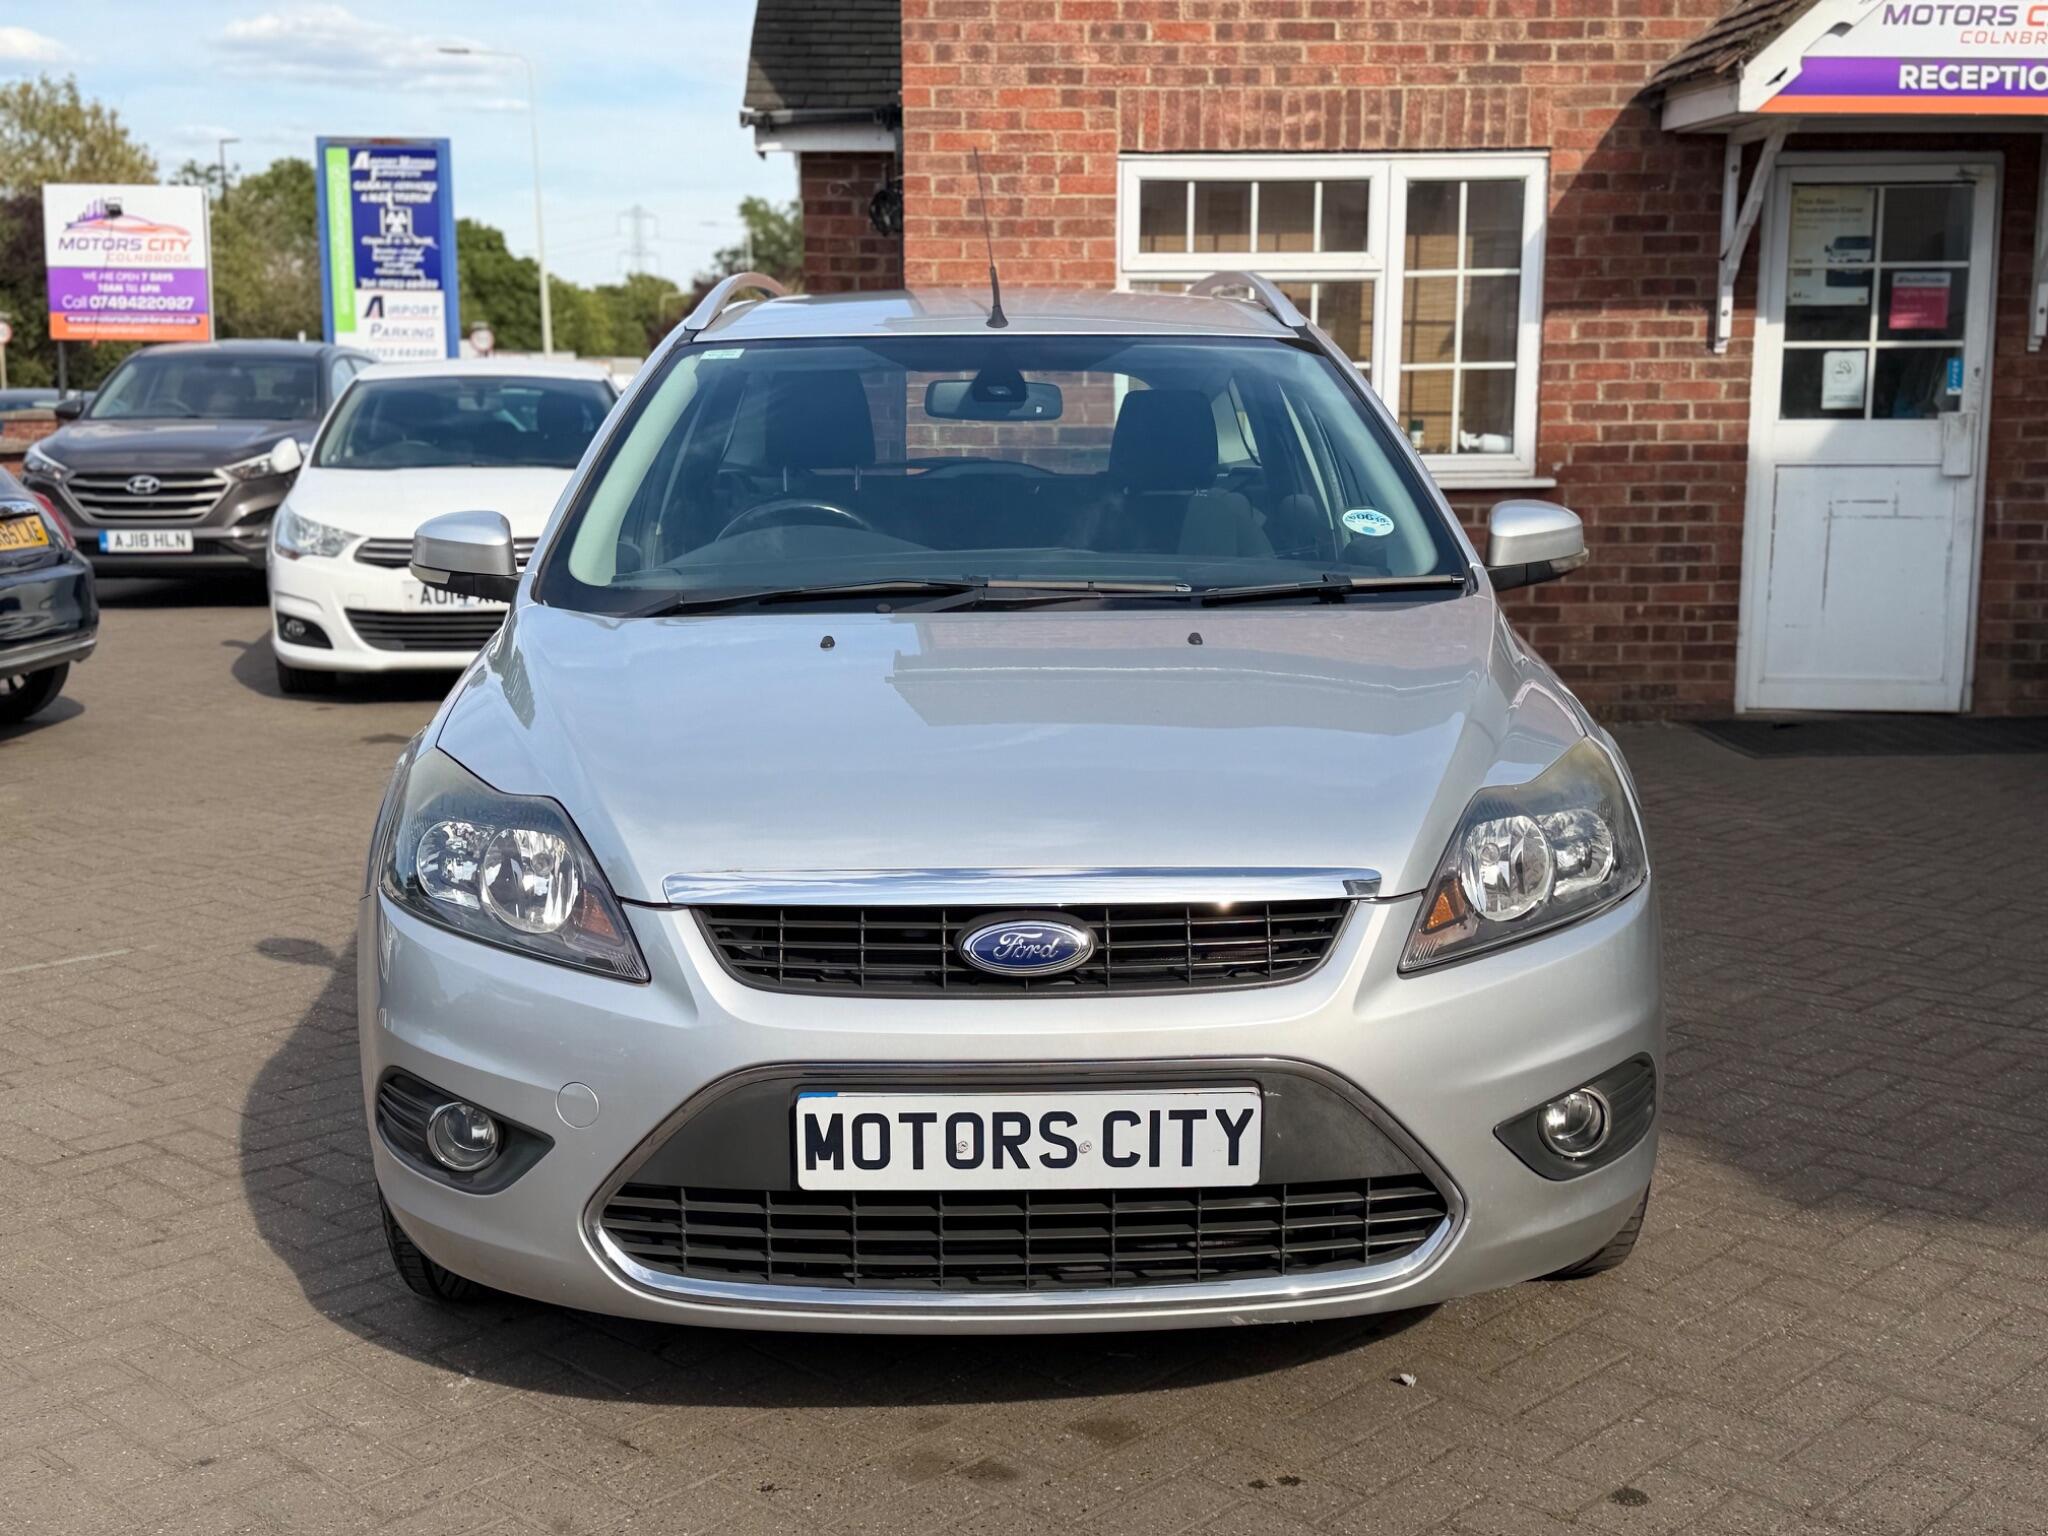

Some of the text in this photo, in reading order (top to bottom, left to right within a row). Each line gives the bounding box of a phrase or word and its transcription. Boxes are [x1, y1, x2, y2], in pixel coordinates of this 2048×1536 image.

[1882, 4, 2018, 26] MOTORS
[58, 237, 192, 251] MOTORS CITY
[62, 295, 195, 311] Call 07494220927
[114, 533, 186, 548] AJ18 HLN
[993, 932, 1060, 959] Ford
[803, 1108, 1255, 1170] MOTORS CITY
